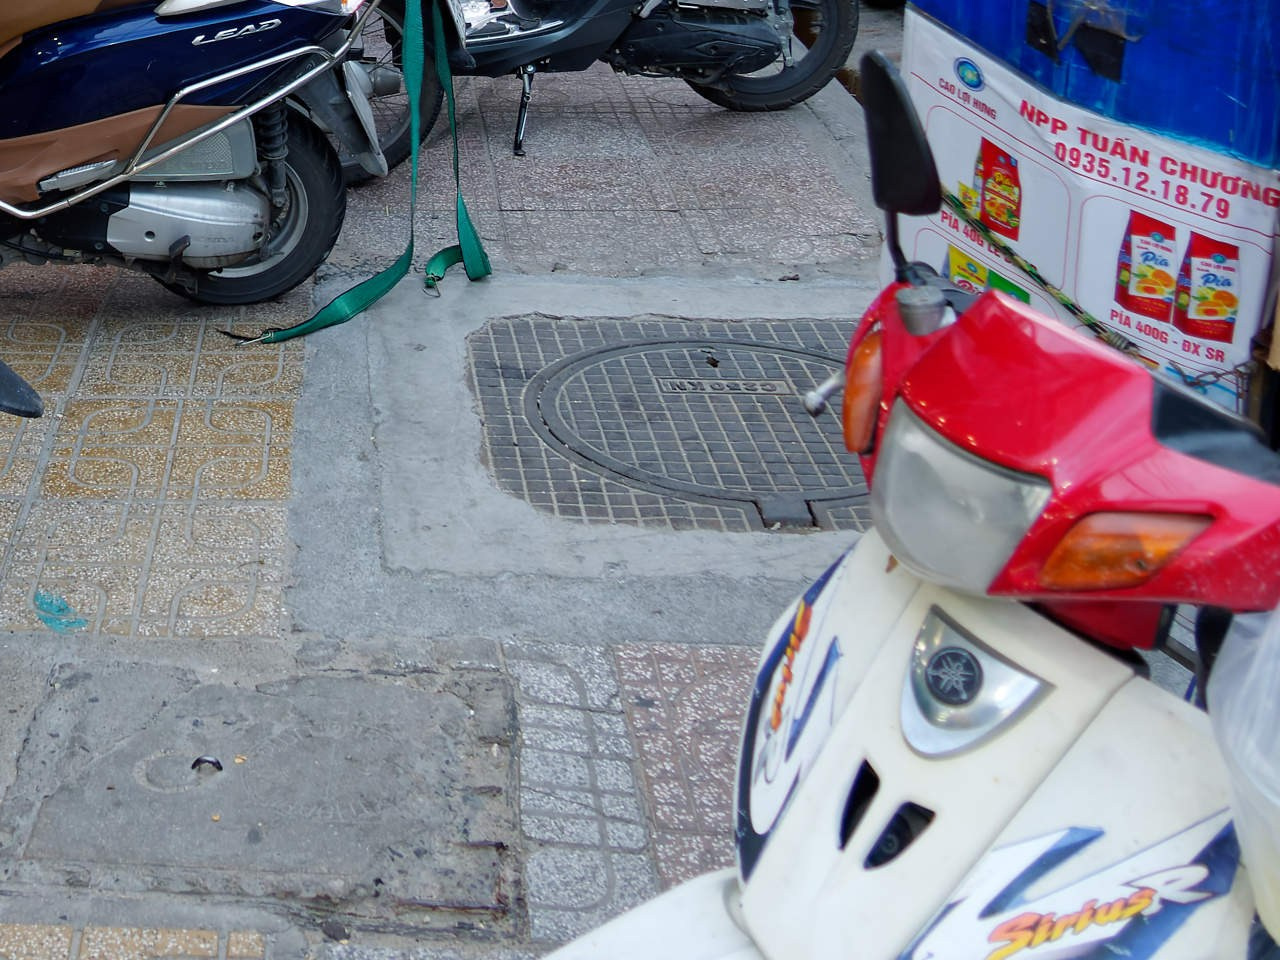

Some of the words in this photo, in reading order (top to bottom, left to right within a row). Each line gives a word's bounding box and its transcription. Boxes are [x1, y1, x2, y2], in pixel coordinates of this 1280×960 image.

[191, 18, 282, 46] LEAD
[938, 78, 956, 95] CAO
[1019, 99, 1068, 135] NPP
[1054, 142, 1230, 219] 0935.12.18.79
[1205, 347, 1226, 363] SR
[984, 886, 1157, 960] Sirius
